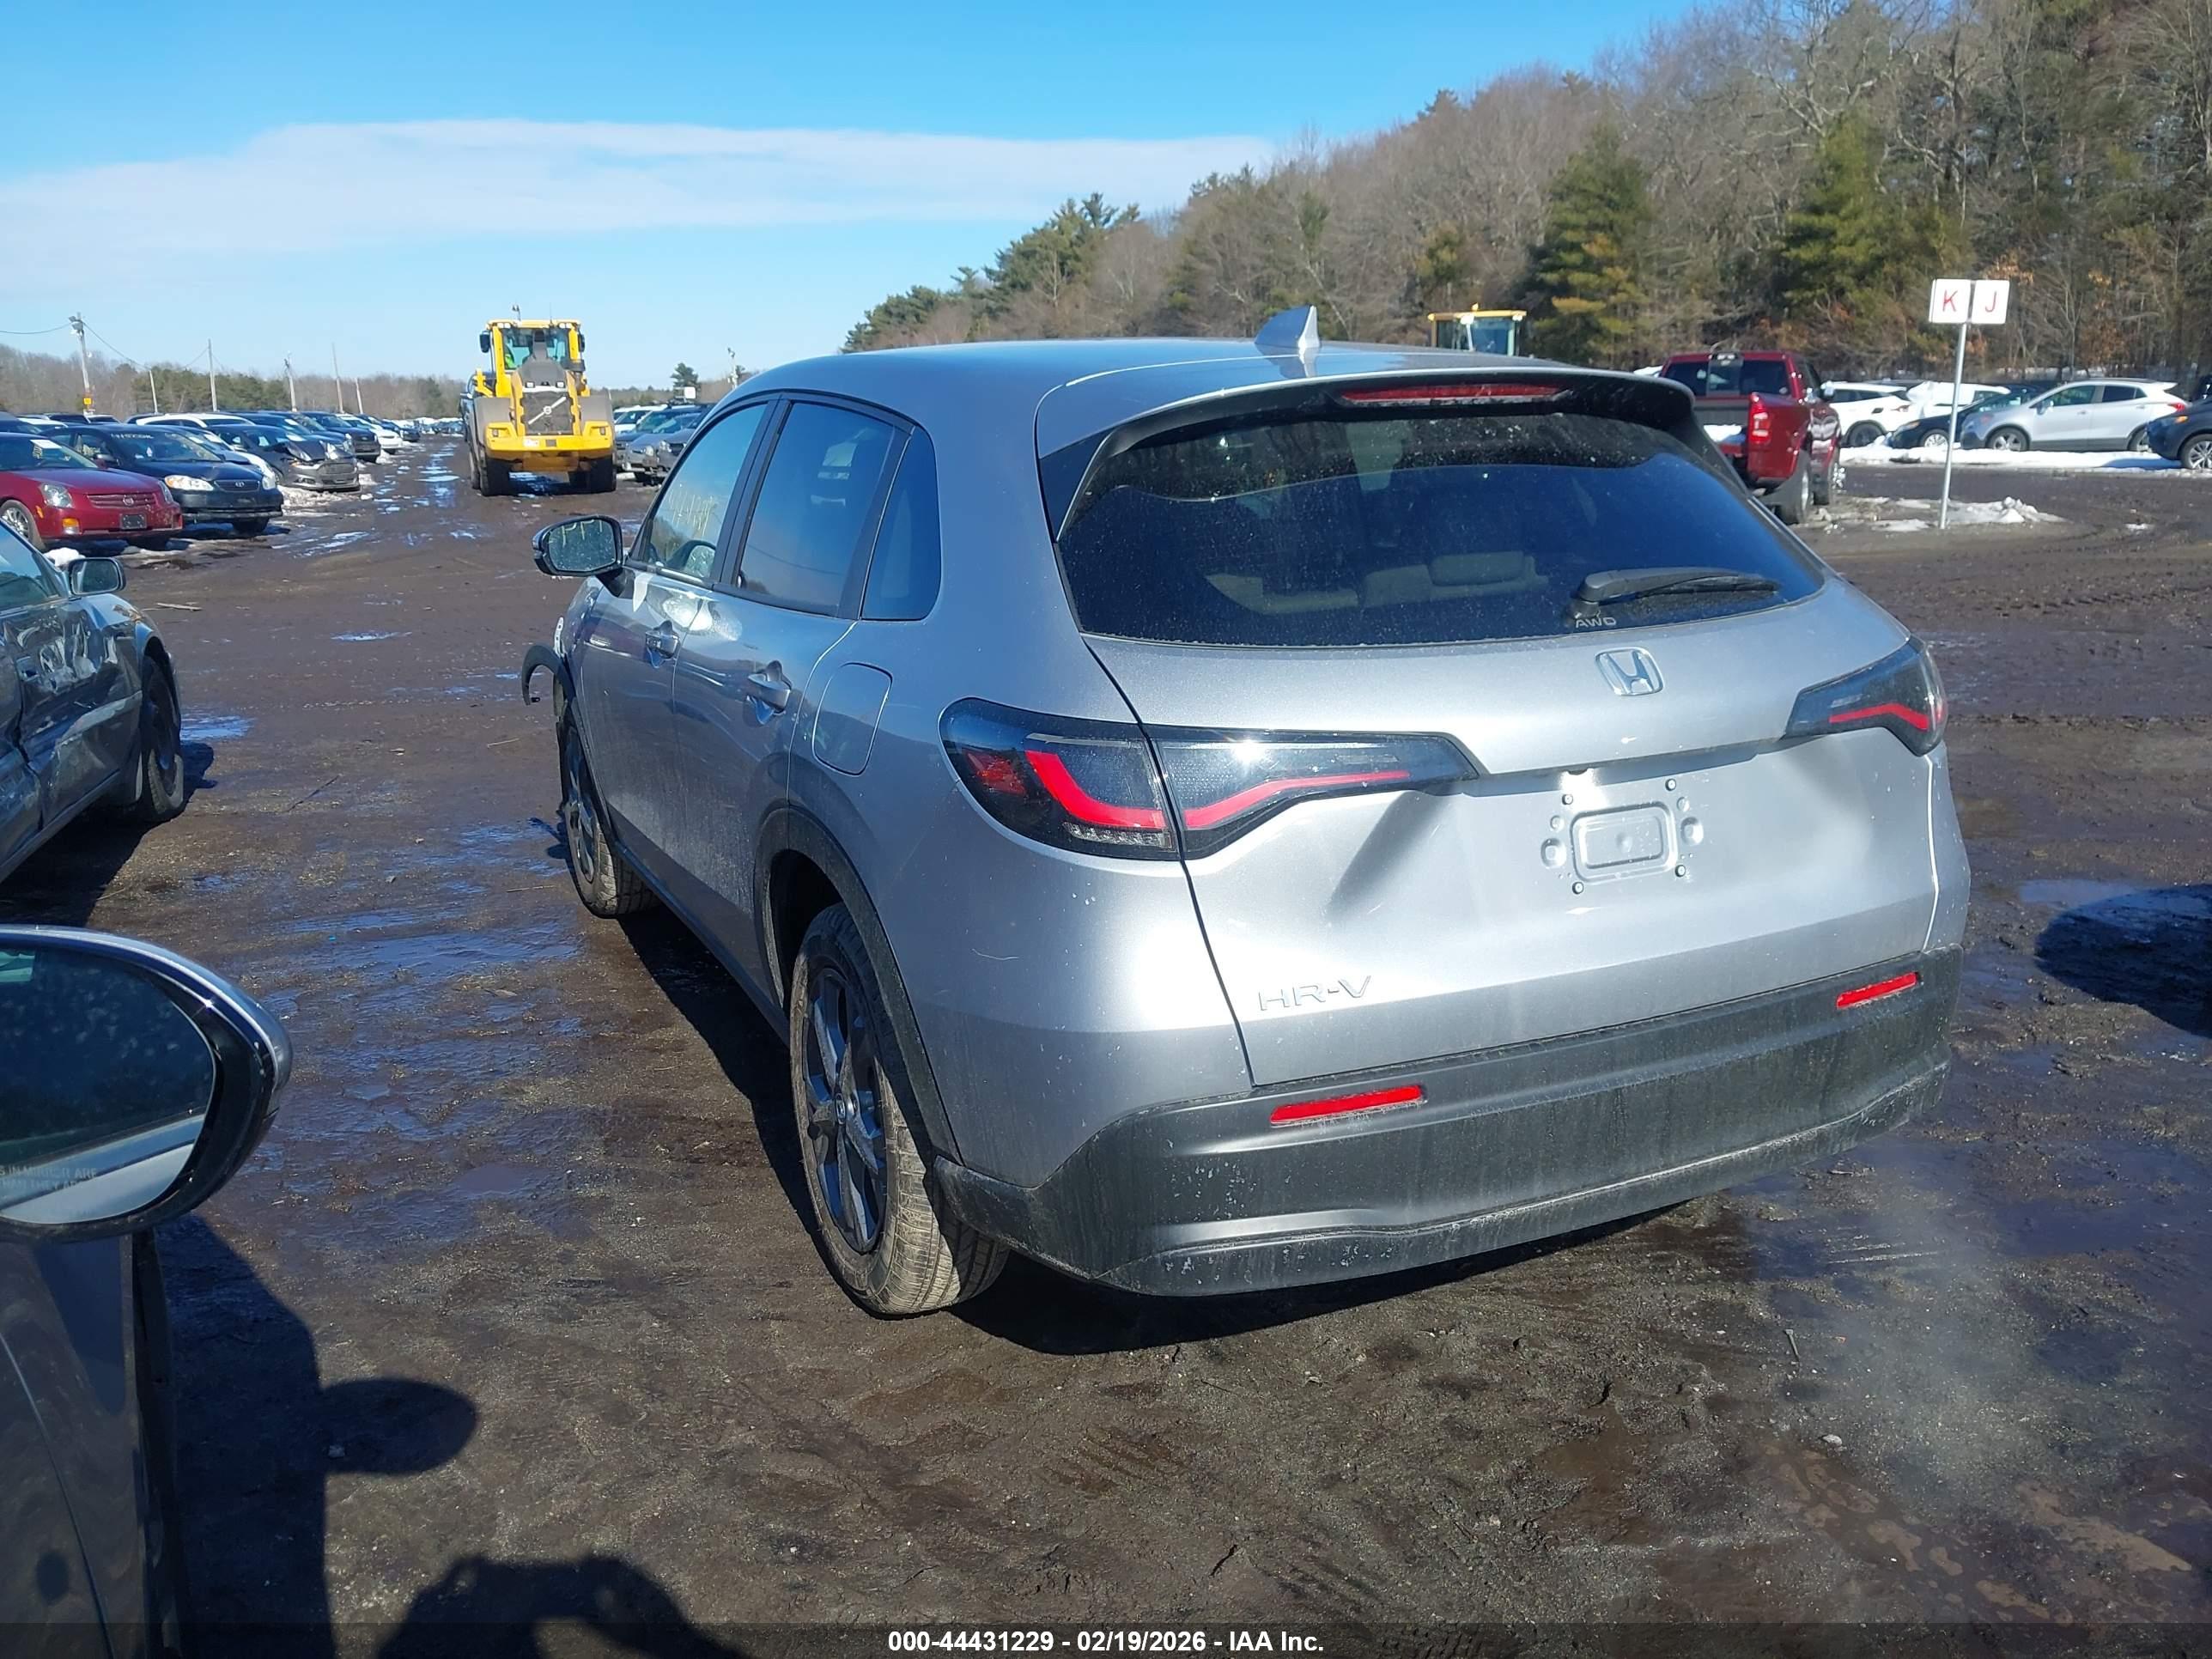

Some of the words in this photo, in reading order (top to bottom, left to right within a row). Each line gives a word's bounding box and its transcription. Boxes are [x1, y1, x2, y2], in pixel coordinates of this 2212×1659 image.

[1942, 289, 1959, 313] K
[1984, 290, 1998, 313] J
[1575, 617, 1617, 629] AWD
[1258, 975, 1372, 1012] HR-V
